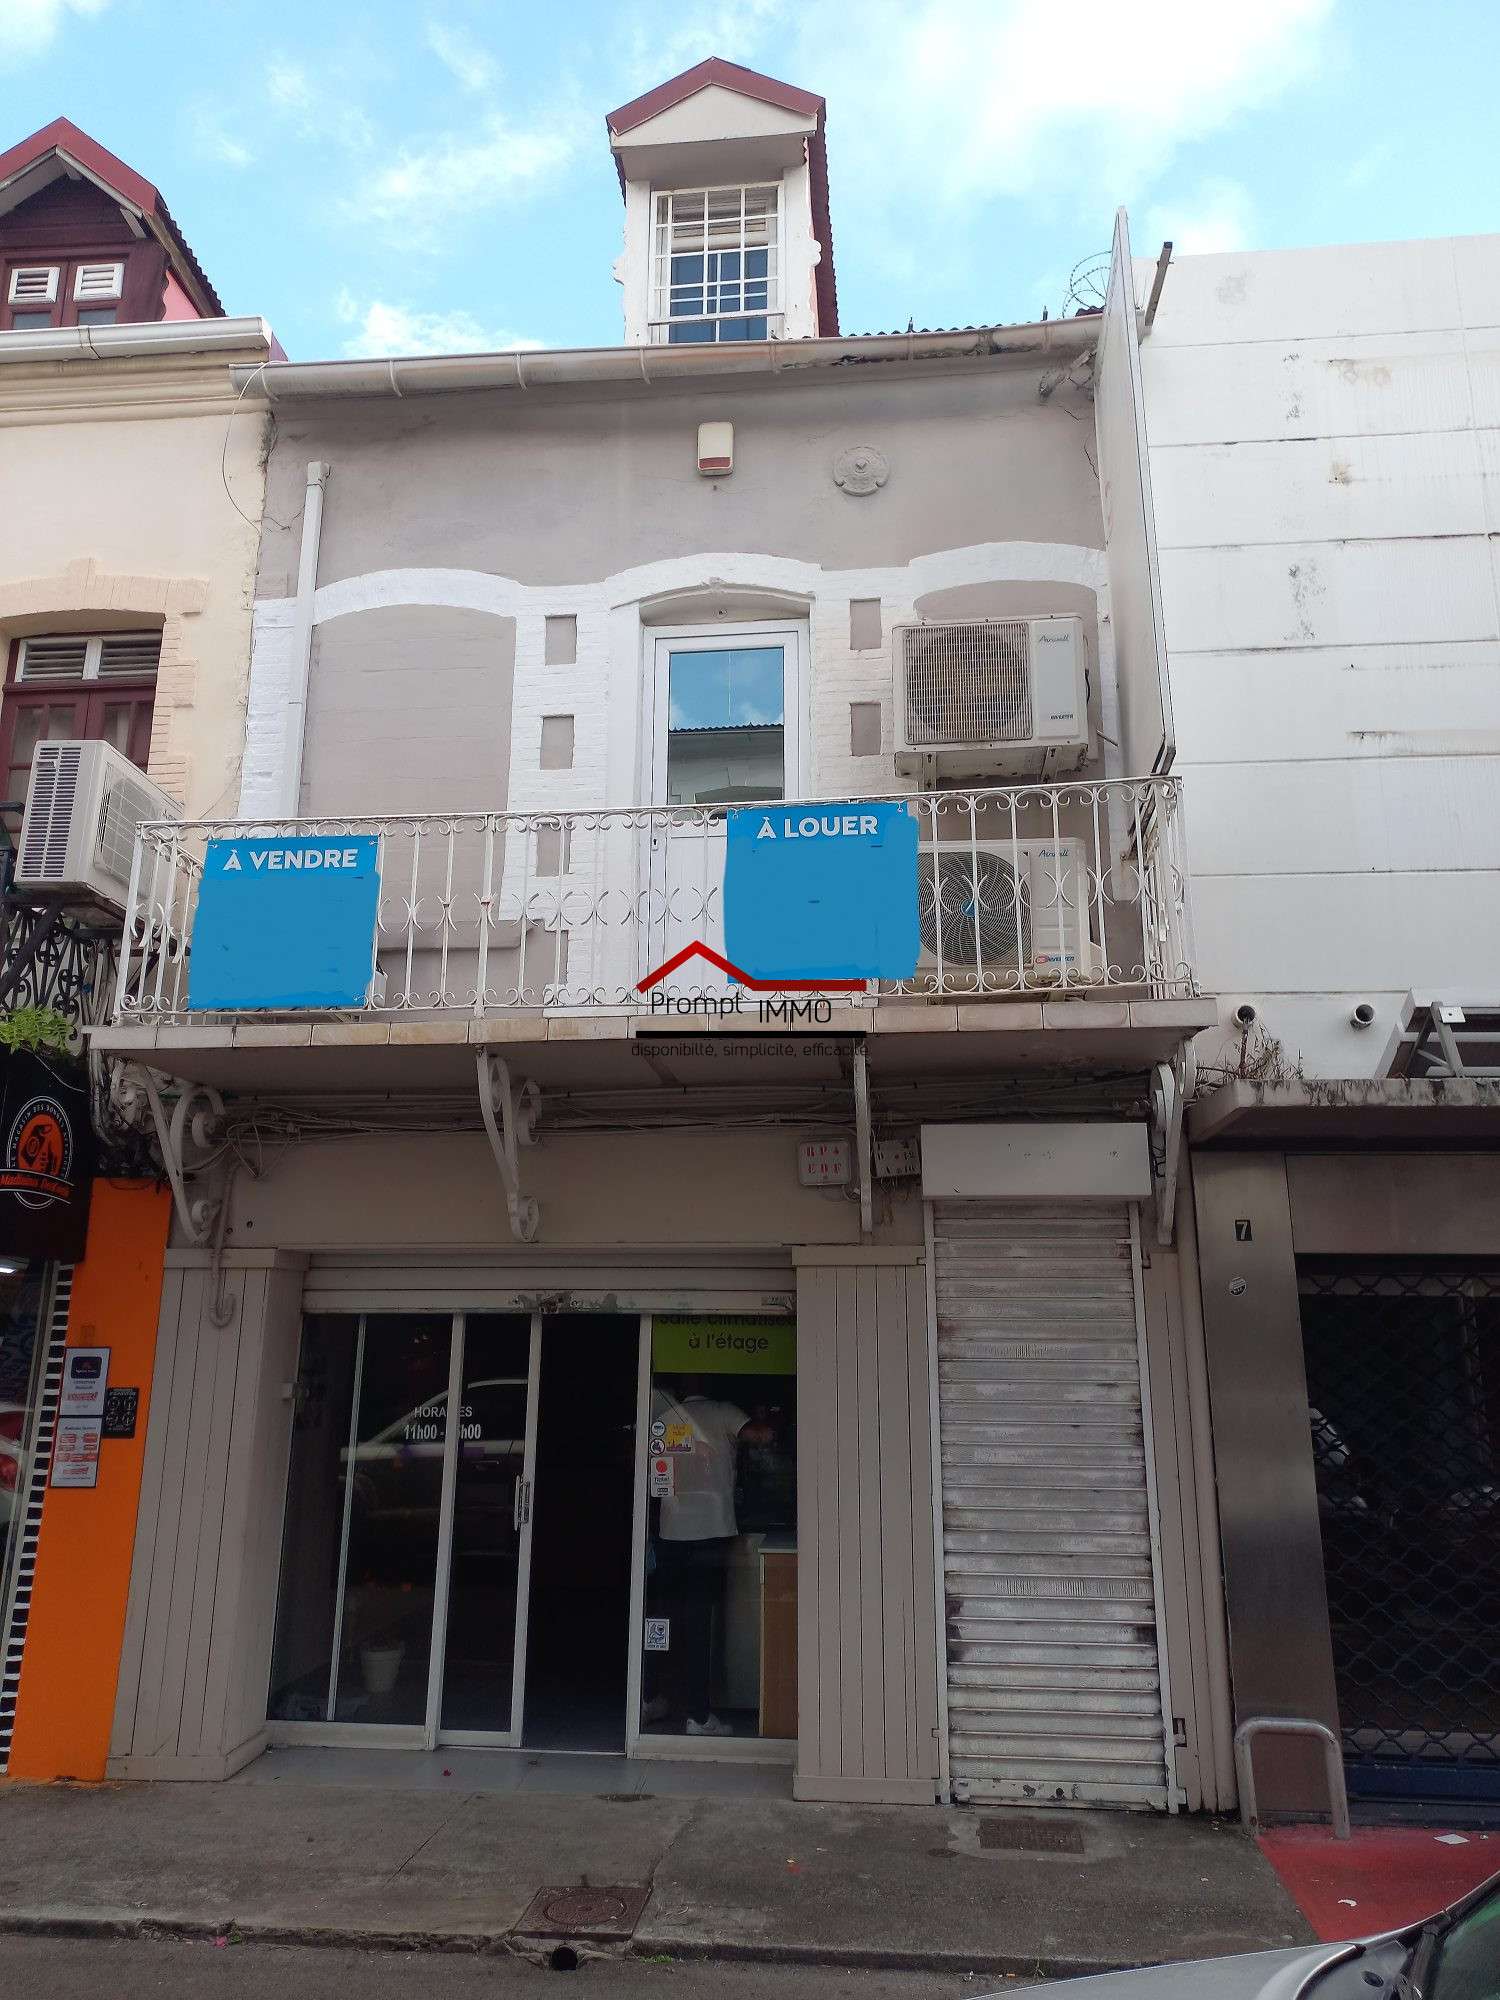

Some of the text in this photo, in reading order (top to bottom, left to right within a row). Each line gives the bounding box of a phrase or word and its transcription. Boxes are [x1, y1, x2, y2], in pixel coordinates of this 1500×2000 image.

[756, 815, 878, 839] À LOUER
[222, 848, 359, 871] À VENDRE
[1236, 1221, 1248, 1241] 7
[688, 1332, 768, 1354] à l'étage
[404, 1423, 438, 1440] 11h00
